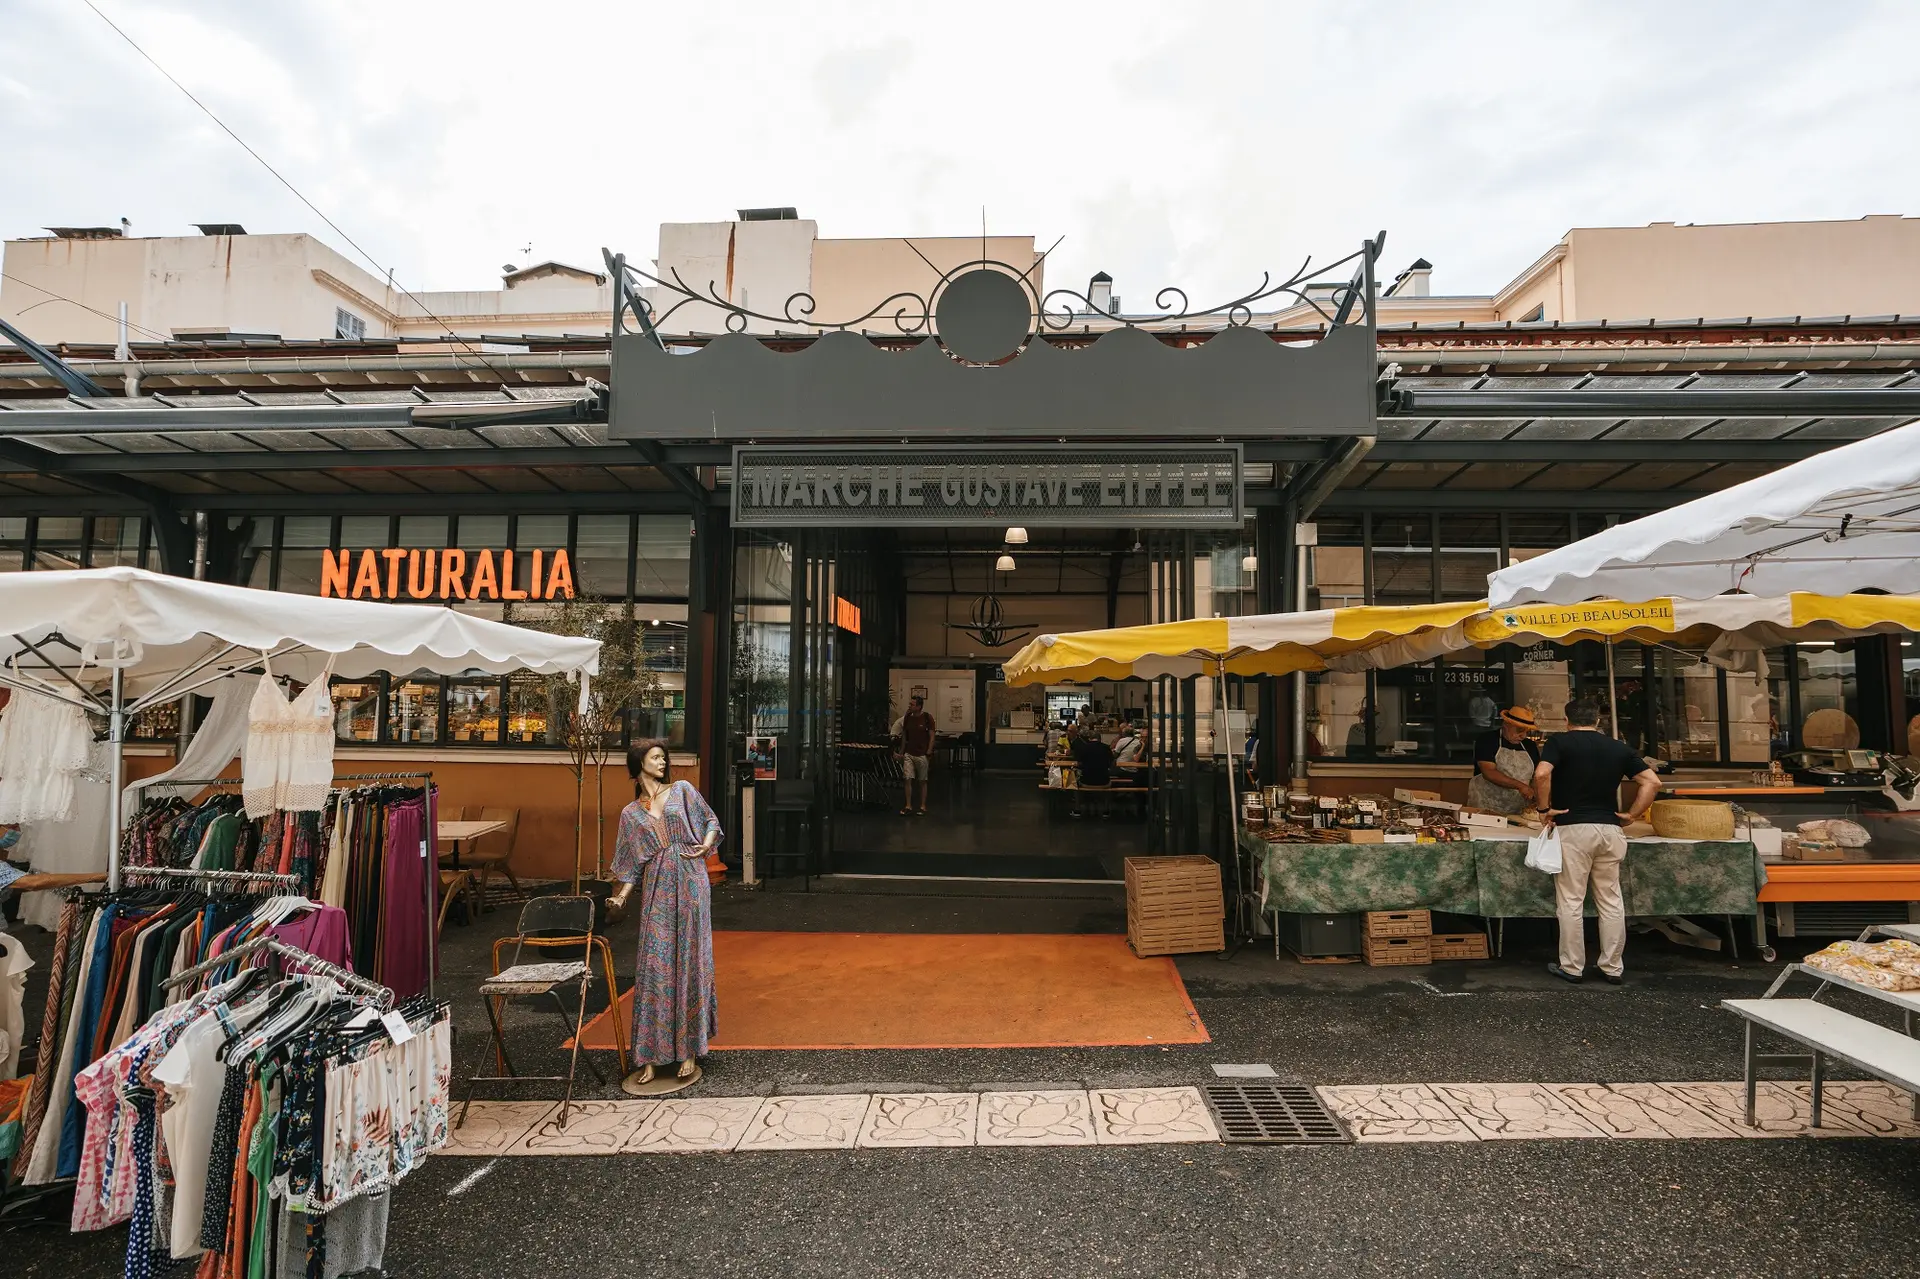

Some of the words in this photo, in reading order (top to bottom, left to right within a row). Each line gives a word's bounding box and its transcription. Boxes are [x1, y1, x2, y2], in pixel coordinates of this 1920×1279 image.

[750, 464, 924, 507] MARCHE
[941, 464, 1083, 507] GUSTAVE
[1099, 463, 1230, 507] EIFFEL
[320, 548, 575, 600] NATURALIA
[1520, 613, 1558, 625] VILLE
[1561, 612, 1580, 624] DE
[1583, 607, 1672, 622] BEAUSOLEIL
[1523, 649, 1554, 661] CORNER
[1414, 674, 1426, 682] TEL
[1444, 672, 1456, 683] 23
[1459, 672, 1471, 683] 35
[1473, 672, 1485, 683] 50
